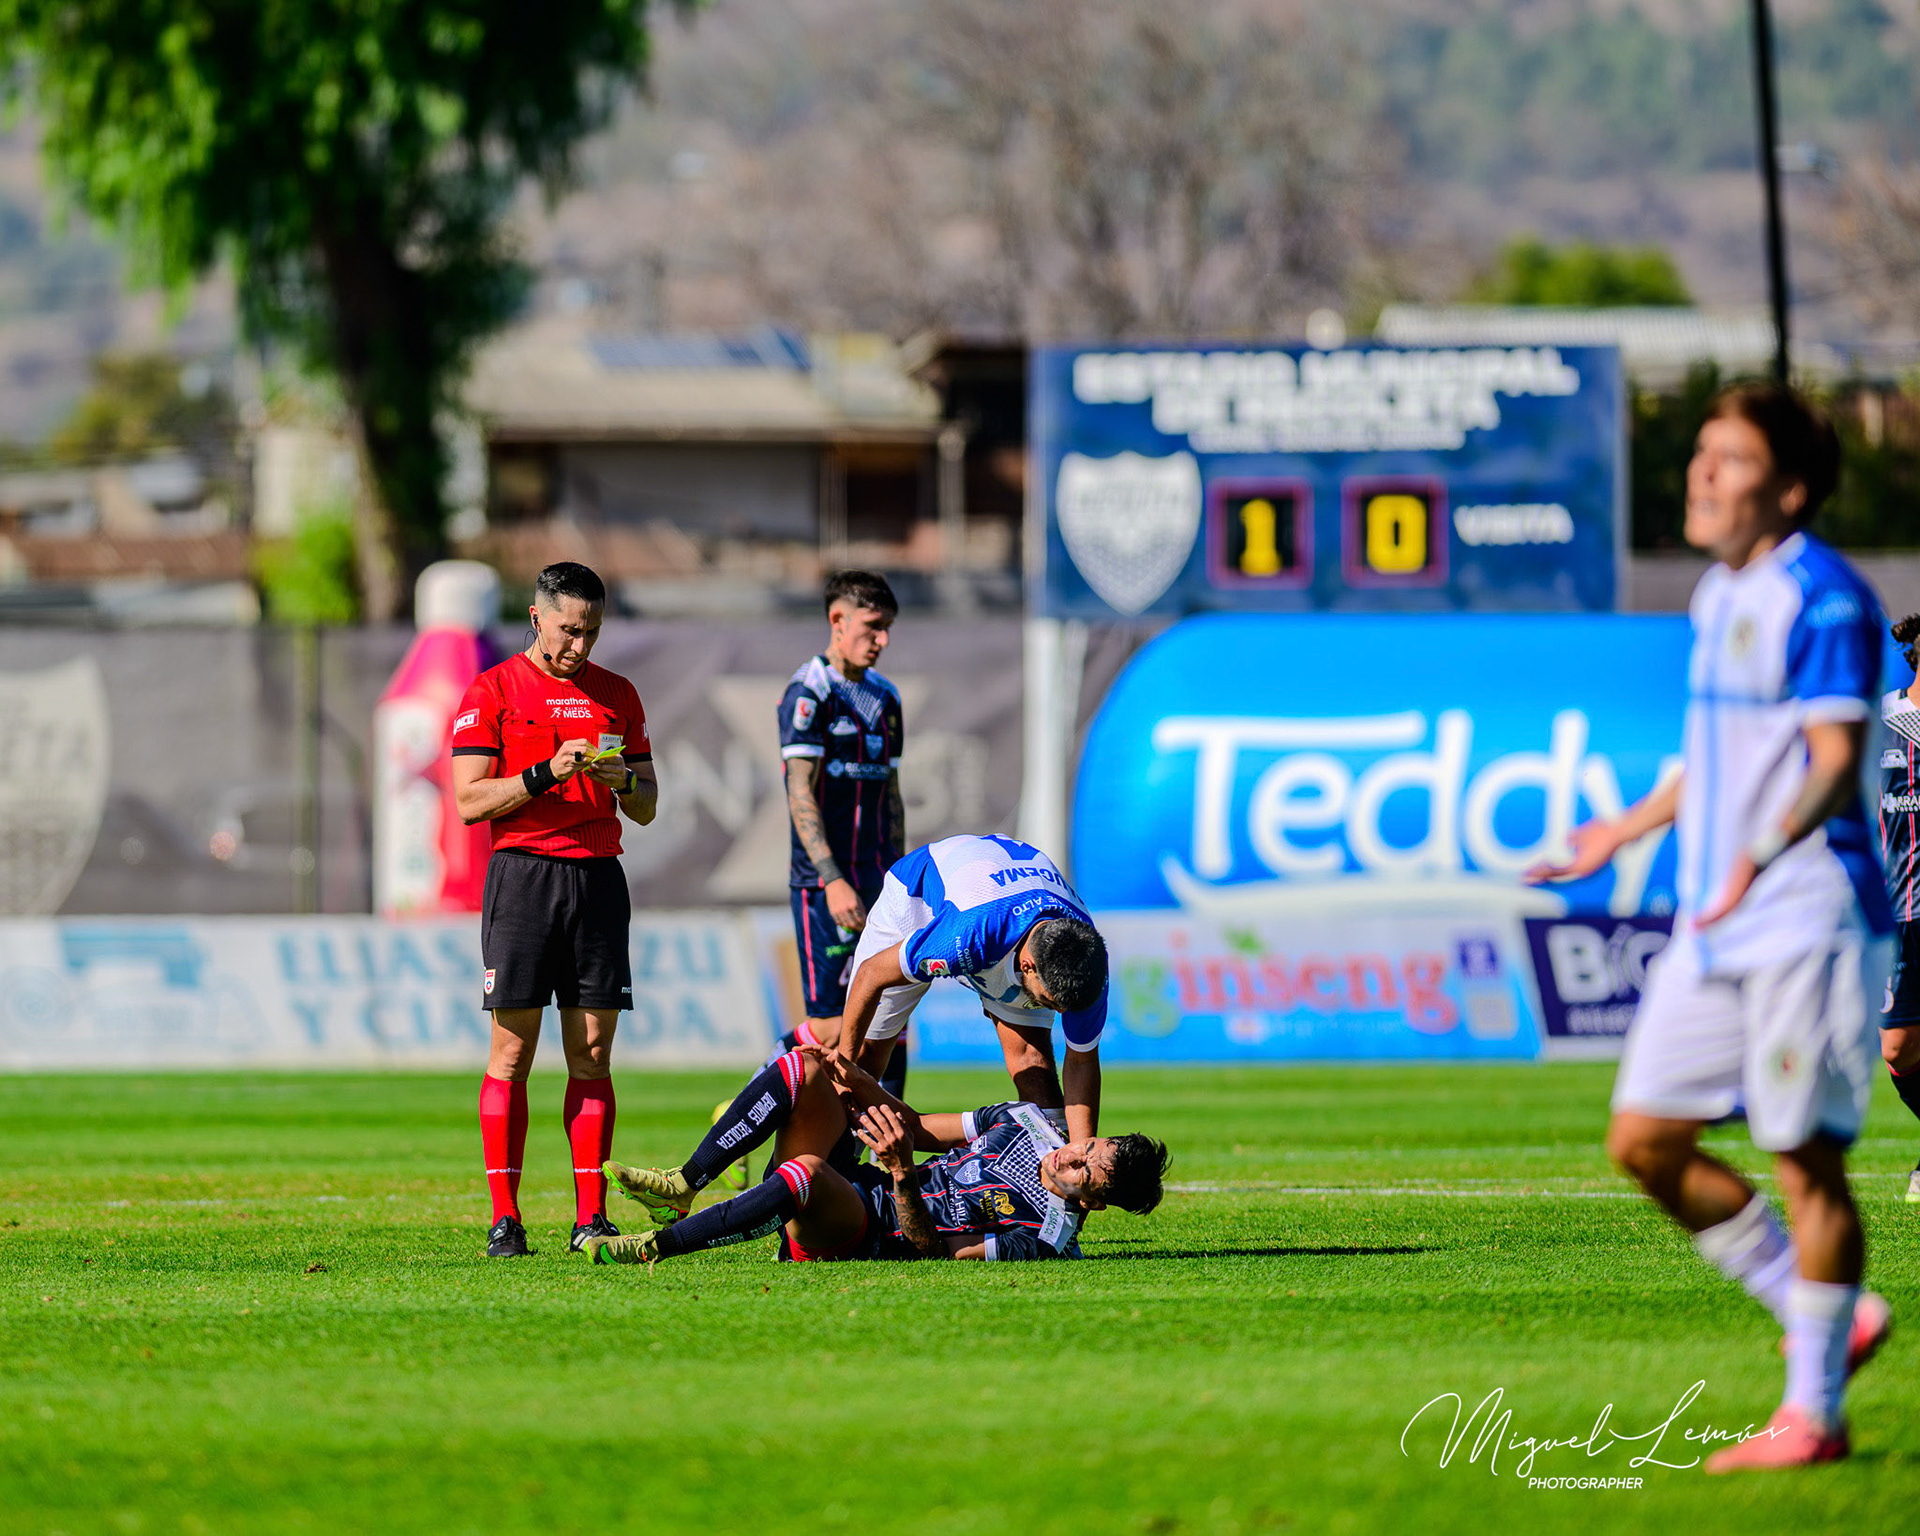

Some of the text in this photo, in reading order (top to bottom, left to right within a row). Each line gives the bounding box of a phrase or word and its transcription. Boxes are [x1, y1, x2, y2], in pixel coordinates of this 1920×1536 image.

[1240, 494, 1427, 576] 1 0
[546, 697, 591, 707] marathon
[1012, 896, 1042, 916] ALTO
[1120, 930, 1459, 1038] ginseng
[748, 1091, 778, 1127] DEPORTES
[716, 1119, 753, 1150] RECOLETA
[750, 1214, 783, 1240] DEPORTES
[954, 1200, 968, 1226] HILL
